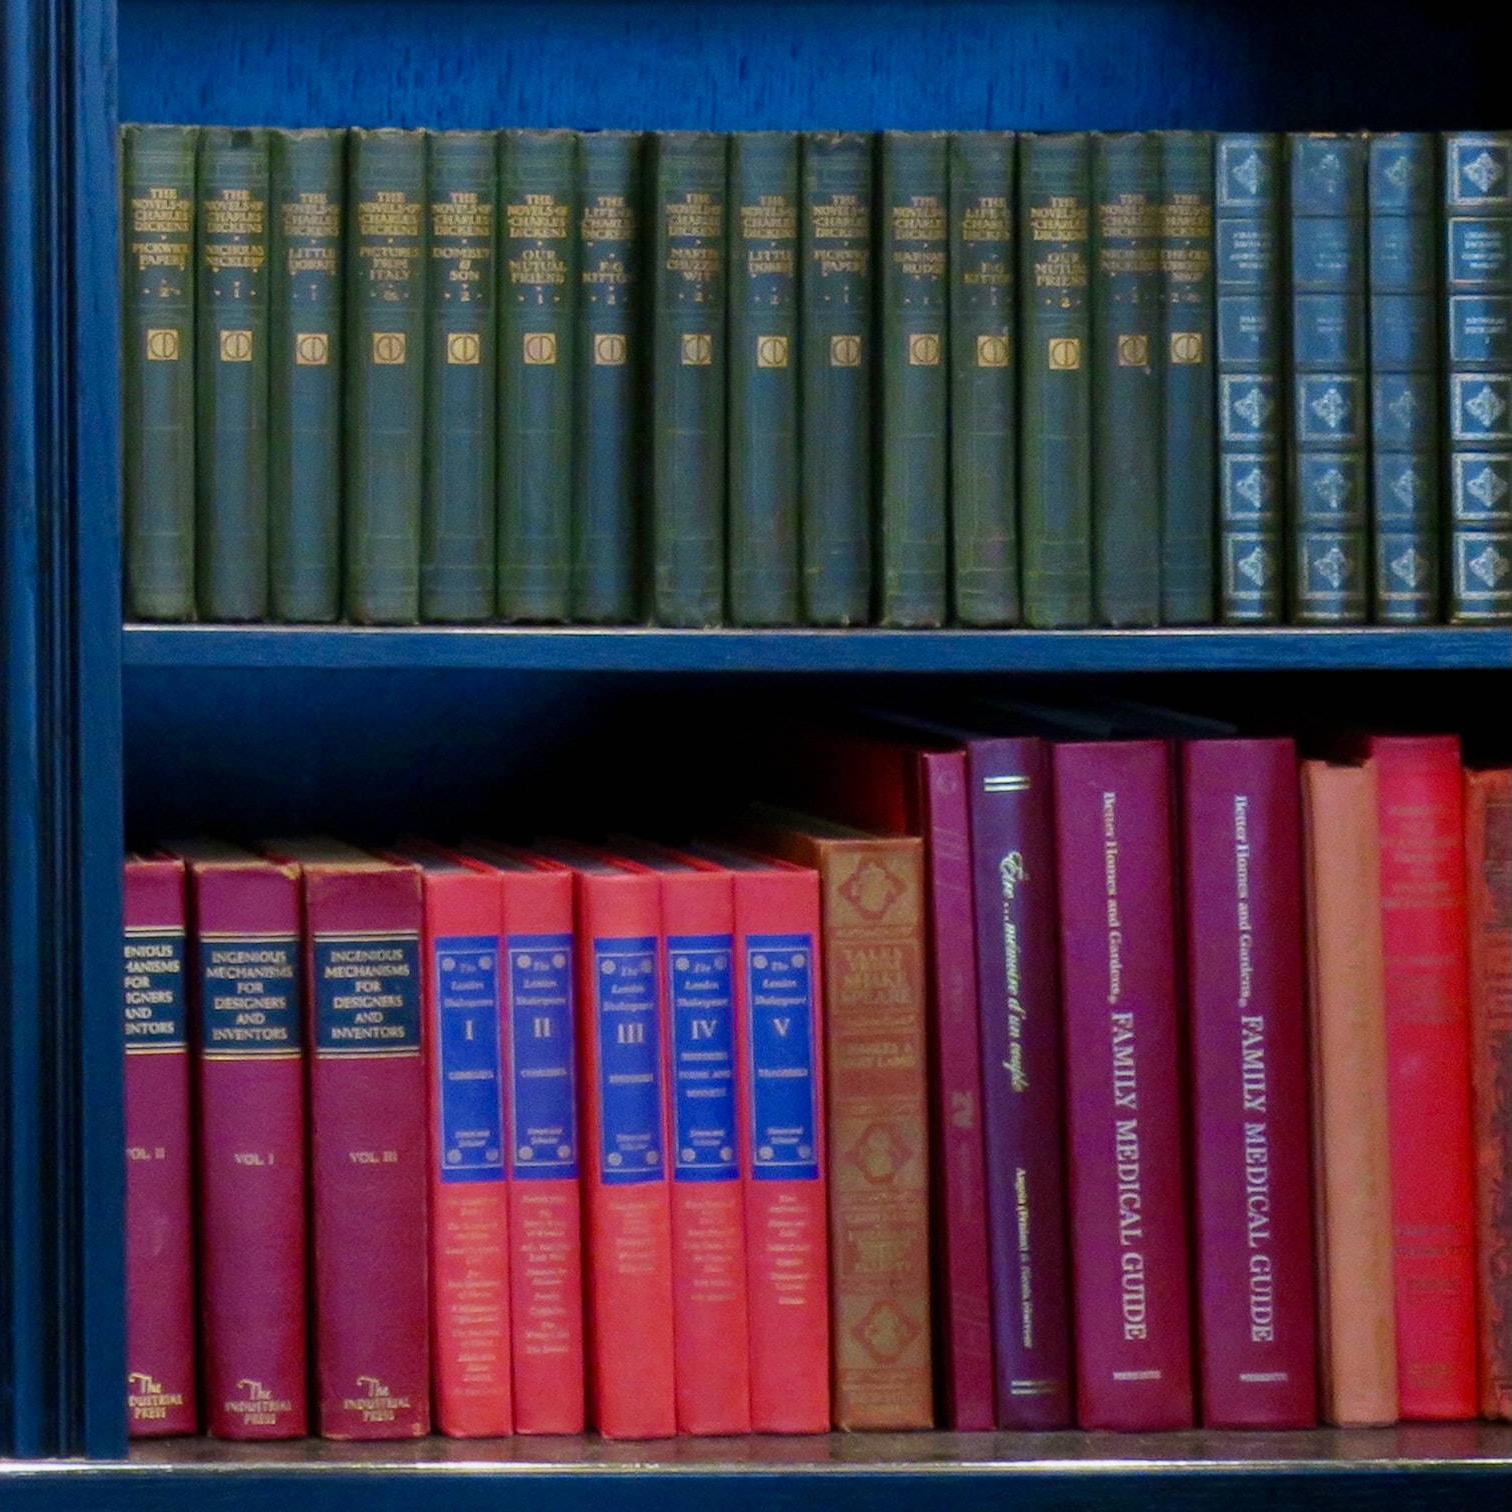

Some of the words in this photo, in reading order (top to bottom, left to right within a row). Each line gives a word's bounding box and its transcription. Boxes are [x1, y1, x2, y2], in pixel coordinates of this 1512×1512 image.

[1104, 792, 1116, 837] Better
[1105, 841, 1118, 896] Homes
[1107, 899, 1121, 927] and
[331, 950, 403, 962] INGENIOUS
[324, 964, 410, 978] MECHANISMS
[355, 981, 381, 992] FOR
[333, 996, 403, 1008] DESIGNERS
[355, 1012, 383, 1023] AND
[332, 1027, 405, 1039] INVENTORS
[1111, 1012, 1137, 1111] FAMILY
[1115, 1119, 1144, 1246] MEDICAL
[1120, 1253, 1147, 1340] GUIDE
